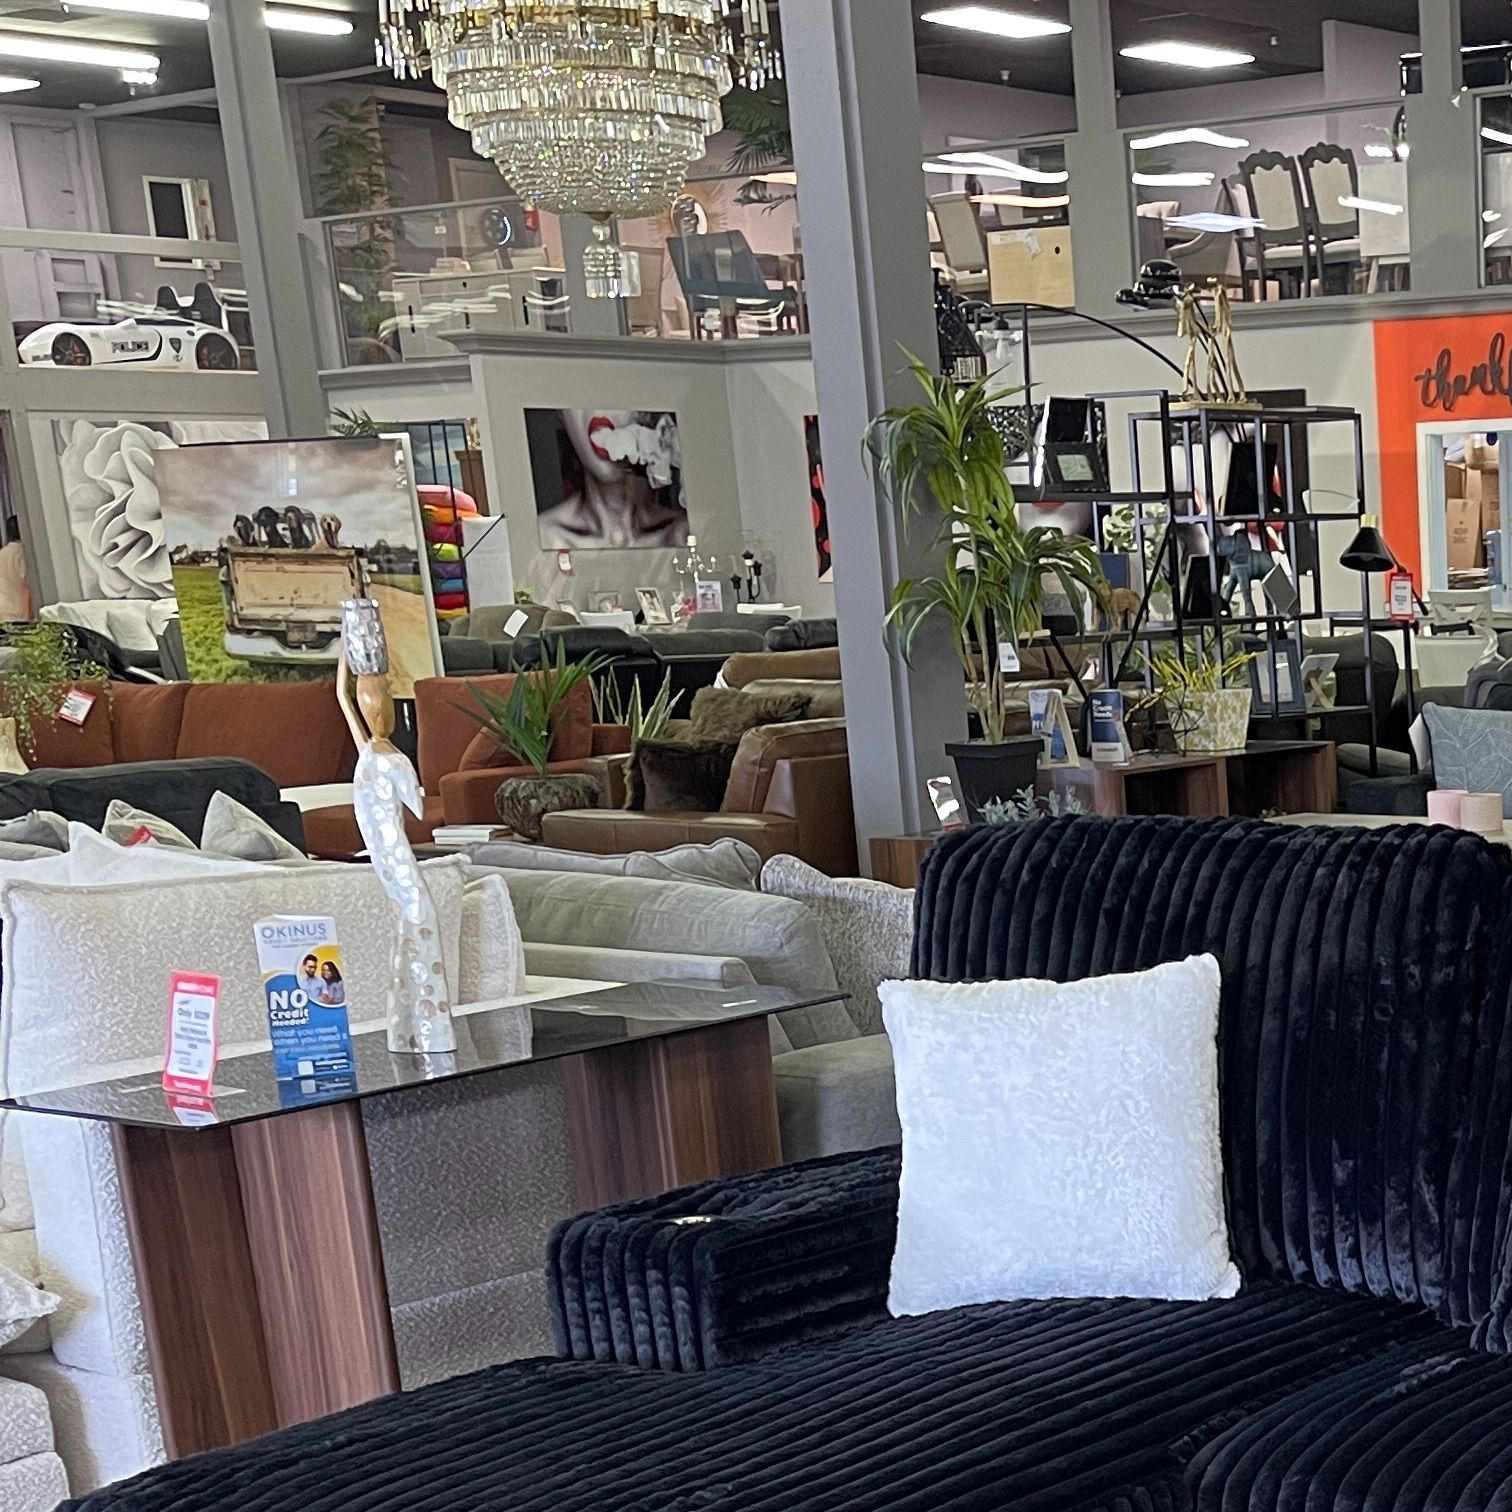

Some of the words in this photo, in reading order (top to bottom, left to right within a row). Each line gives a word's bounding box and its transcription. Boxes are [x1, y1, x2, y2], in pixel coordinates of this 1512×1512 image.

[261, 922, 327, 939] OKINUS
[269, 988, 308, 1010] NO
[270, 1008, 309, 1020] Credit
